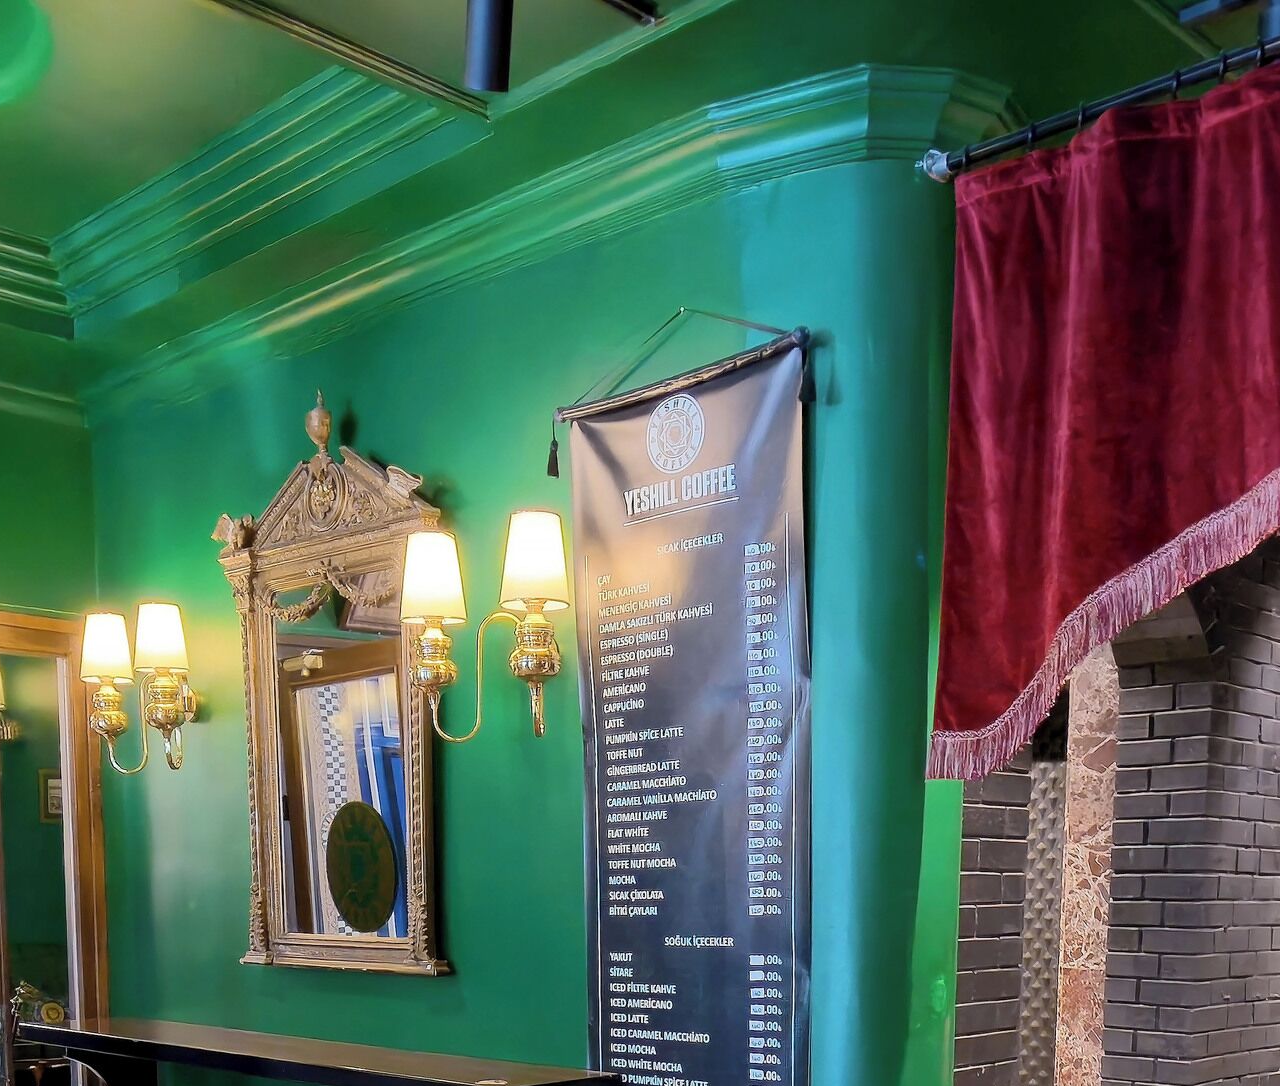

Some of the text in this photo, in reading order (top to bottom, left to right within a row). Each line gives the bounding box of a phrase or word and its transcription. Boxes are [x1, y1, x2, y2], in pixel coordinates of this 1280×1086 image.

[624, 464, 736, 517] YESHILL COFFEE
[680, 533, 724, 552] İÇECEKLER
[597, 575, 611, 587] ÇAY
[598, 580, 650, 602] TÜRK KAHVESİ
[598, 593, 672, 619] MENENGİÇ KAHVESİ
[599, 602, 713, 634] DAMLA SAKIZLI TÜRK KAHVESİ
[600, 628, 669, 650] ESPRESSO (SİNGLE)
[601, 644, 674, 666] ESPRESSO (DOUBLE)
[602, 665, 650, 682] FİLTRE KAHVE
[603, 682, 646, 698] AMERİCANO
[604, 698, 645, 714] CAPPUCİNO
[604, 717, 625, 729] LATTE
[605, 726, 684, 745] PUMPKİN SPİCE LATTE
[606, 747, 643, 761] TOFFE NUT
[658, 760, 680, 772] LATTE
[607, 775, 687, 792] CARAMEL MACCHİATO
[607, 788, 717, 808] CARAMEL VANİLLA MACHİATO
[607, 810, 668, 823] AROMALI KAHVE
[607, 826, 649, 838] FLAT WHİTE
[608, 842, 661, 854] WHİTE MOCHA
[608, 858, 677, 870] TOFFE NUT MOCHA
[608, 875, 636, 885] MOCHA
[609, 889, 664, 902] SICAK ÇİKOLATA
[609, 905, 658, 918] BİTKİ ÇAYLARI
[664, 935, 734, 949] SOĞUK İÇECEKLER
[609, 952, 633, 962] YAKUT
[609, 965, 633, 978] SİTARE
[610, 981, 677, 995] ICED FİLTRE KAHVE
[610, 997, 673, 1010] ICED AMERİCANO
[610, 1013, 649, 1024] ICED LATTE
[610, 1028, 710, 1043] ICED CARAMEL MACCHİATO
[610, 1043, 657, 1055] ICED MOCHA
[611, 1058, 683, 1073] ICED WHİTE MOCHA
[628, 1074, 663, 1086] PUMPKİN
